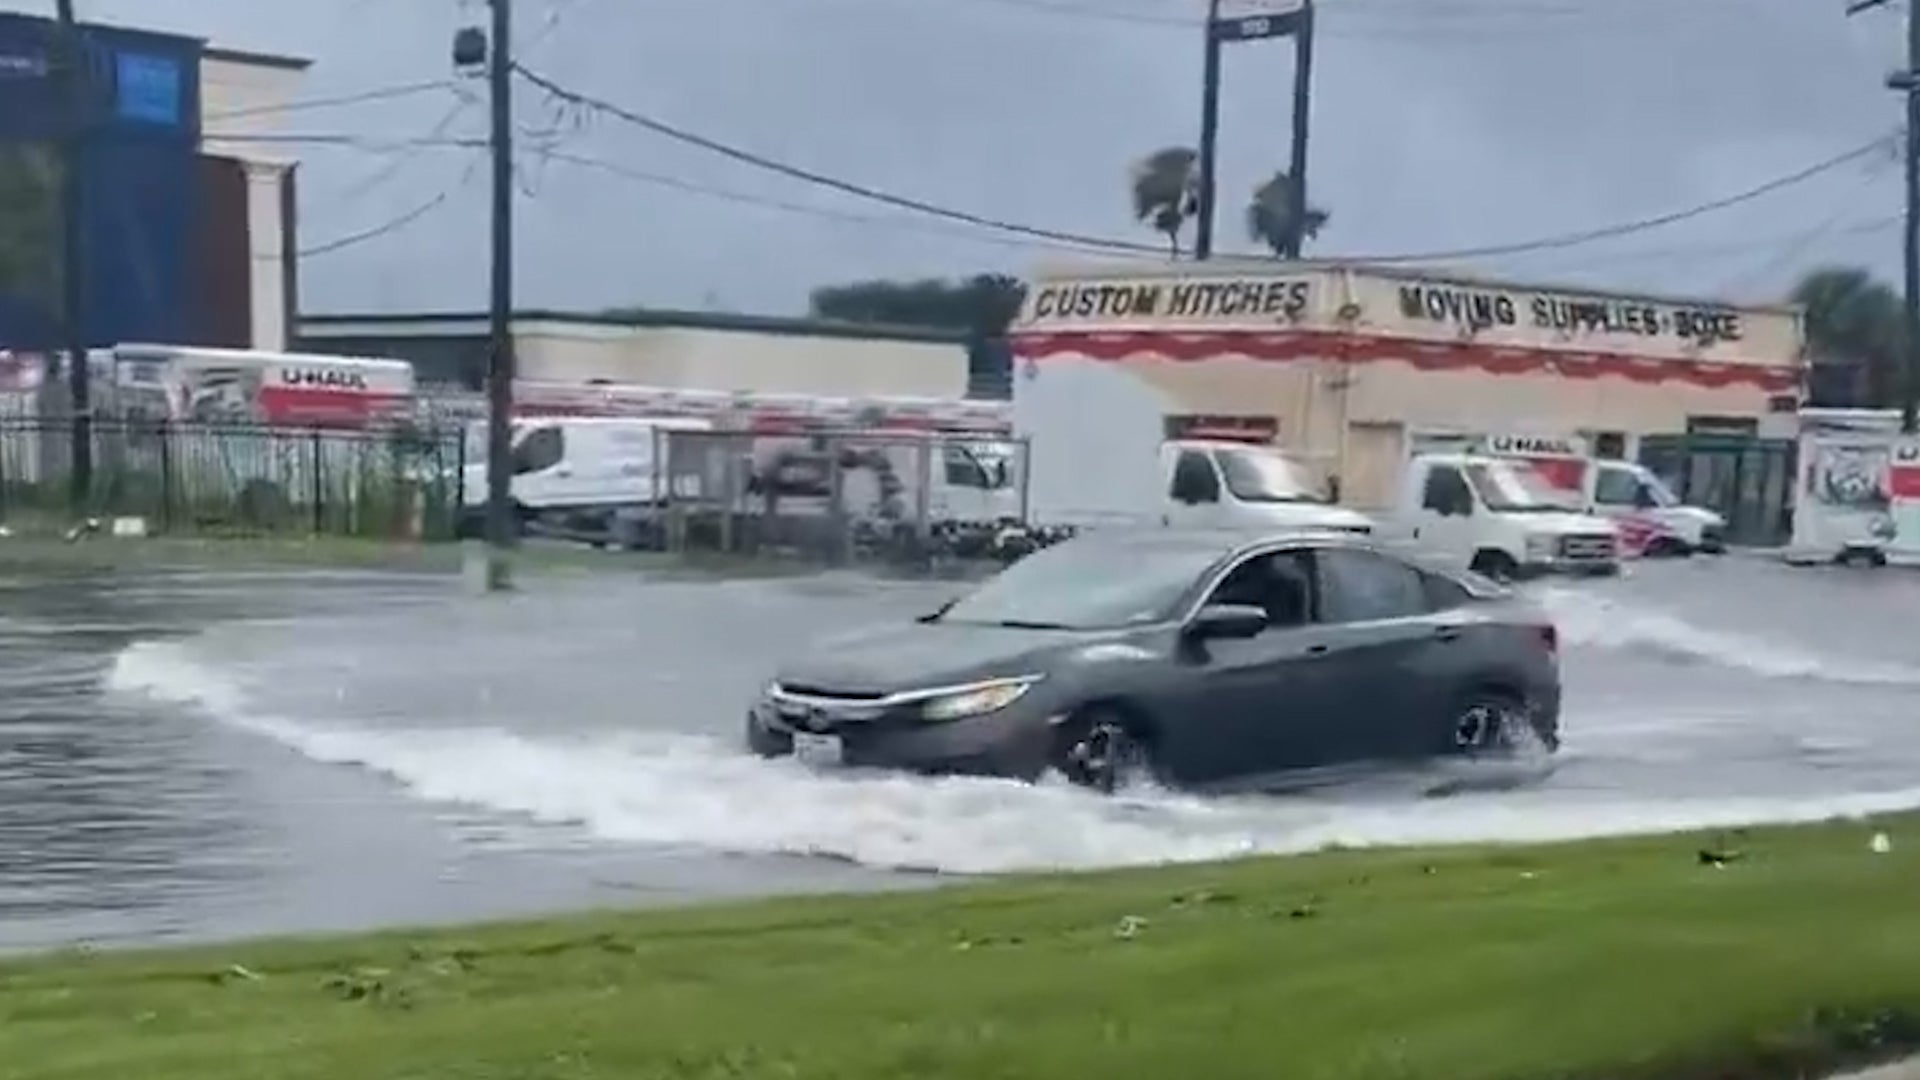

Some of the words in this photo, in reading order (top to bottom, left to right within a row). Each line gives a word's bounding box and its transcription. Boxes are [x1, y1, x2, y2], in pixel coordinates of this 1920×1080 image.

[1036, 285, 1159, 316] CUSTOM
[1167, 281, 1309, 315] HITCHES
[1400, 286, 1516, 327] MOVING
